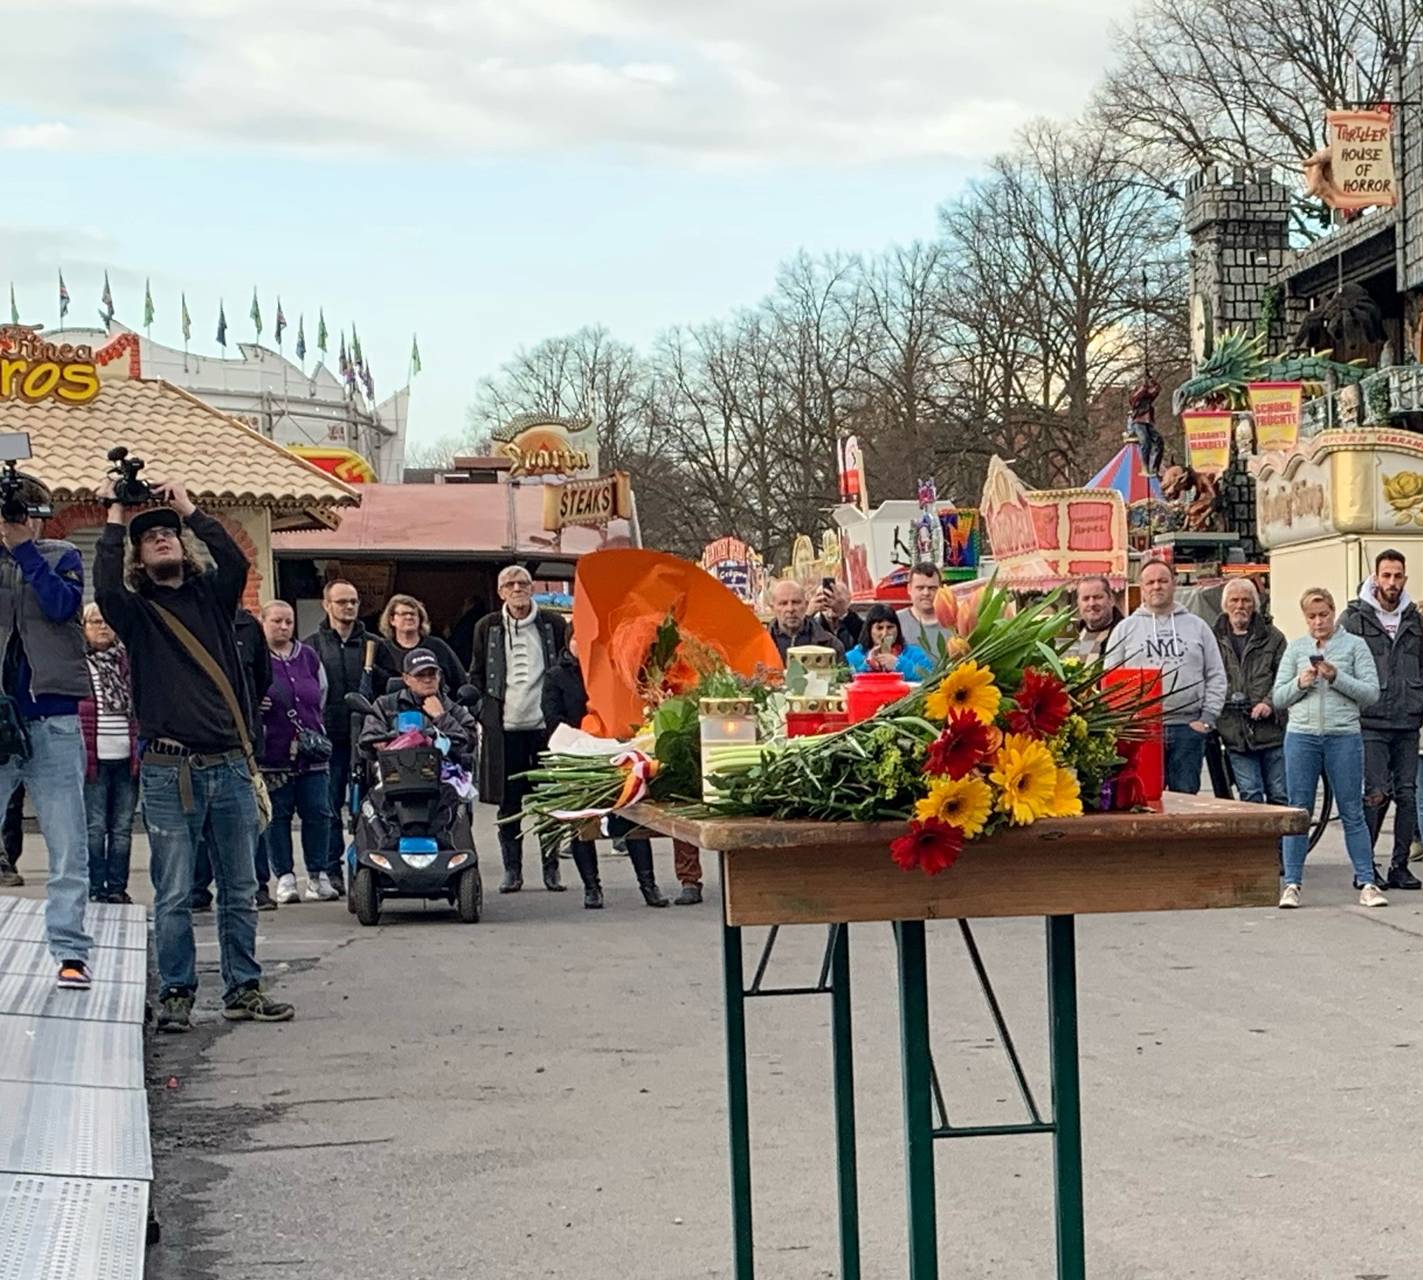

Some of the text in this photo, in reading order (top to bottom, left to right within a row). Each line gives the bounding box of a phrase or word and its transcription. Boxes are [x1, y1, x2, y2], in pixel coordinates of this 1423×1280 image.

[1333, 124, 1388, 142] THRILLER
[1341, 147, 1383, 161] HOUSE
[1355, 163, 1372, 176] OF
[1343, 179, 1391, 192] HORROR
[560, 486, 610, 517] STEAKS
[1145, 638, 1185, 658] NYC
